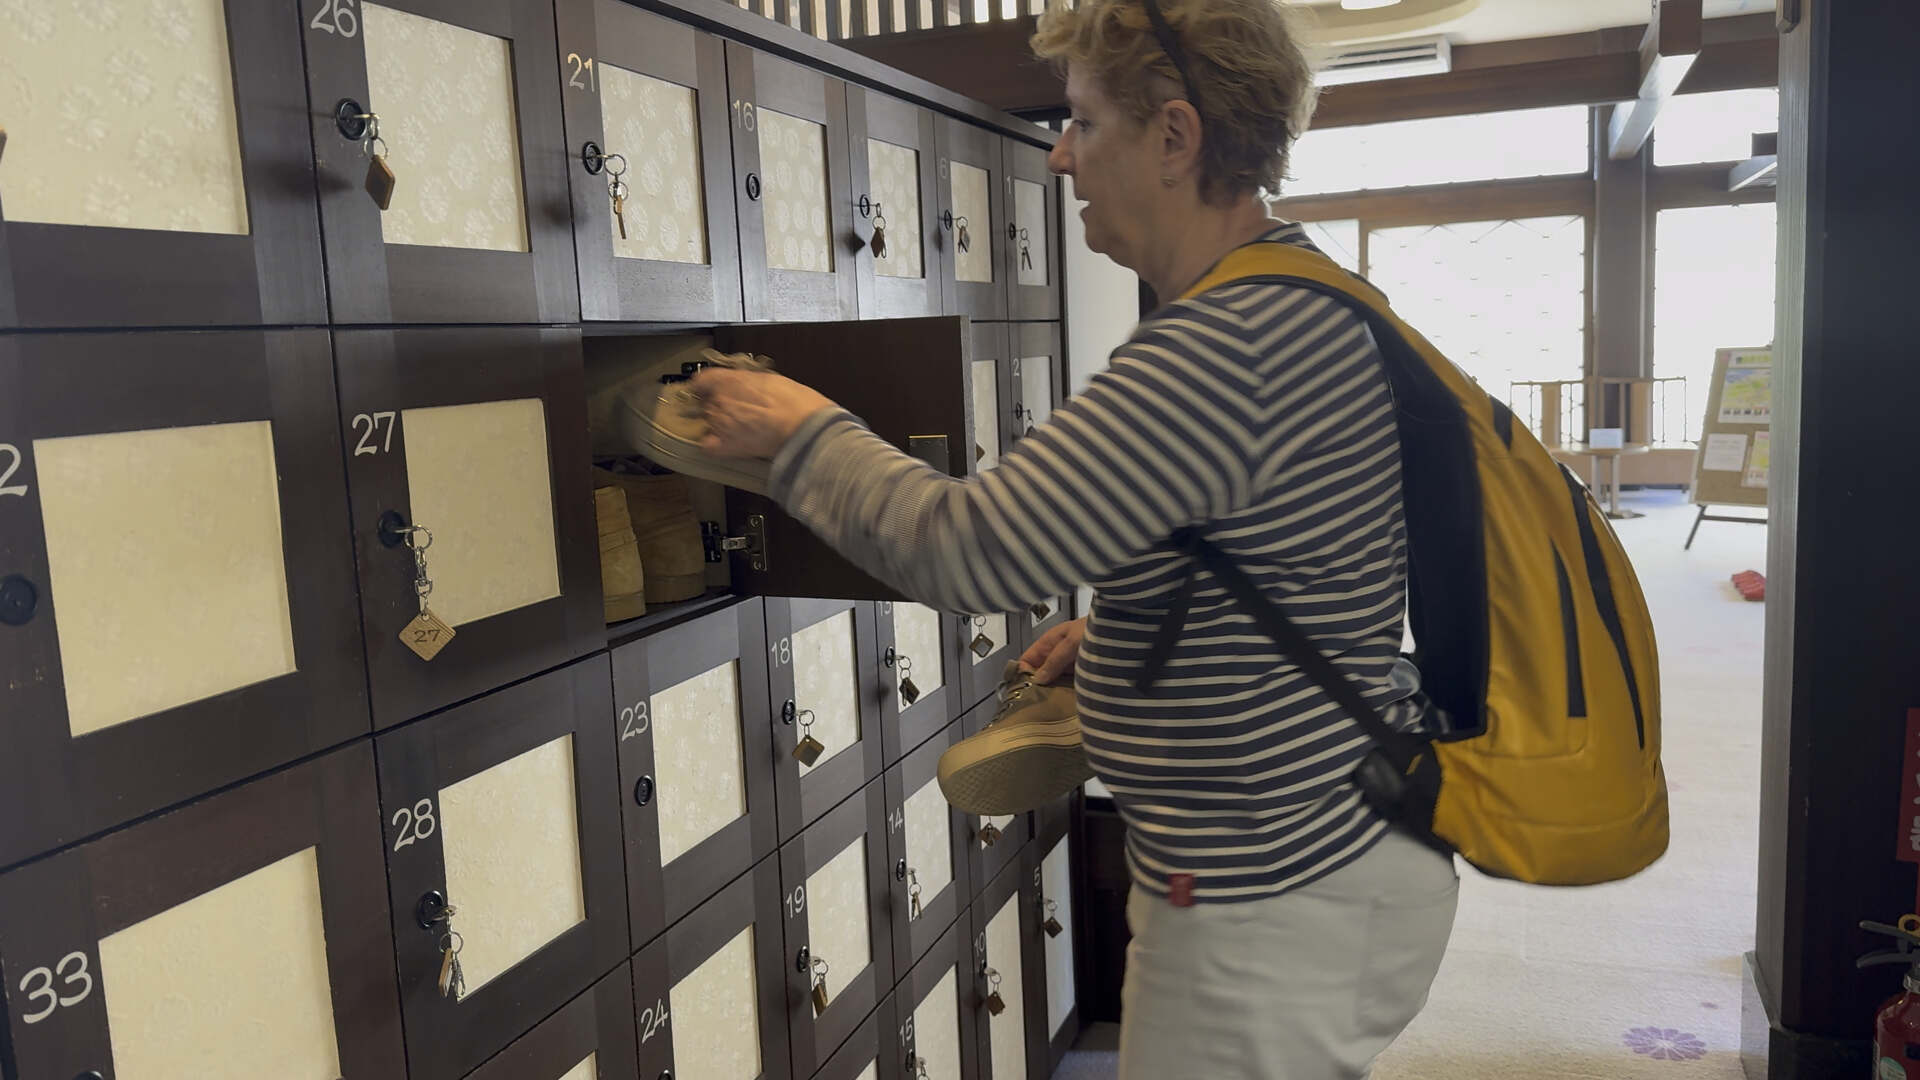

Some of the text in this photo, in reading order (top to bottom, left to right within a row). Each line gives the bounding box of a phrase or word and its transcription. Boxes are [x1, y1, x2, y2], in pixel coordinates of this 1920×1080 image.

[310, 0, 356, 37] 26
[568, 53, 595, 92] 21
[733, 99, 755, 132] 16
[1006, 175, 1012, 194] 1
[1013, 357, 1021, 377] 2
[352, 411, 395, 456] 27
[0, 444, 28, 496] 2
[414, 629, 441, 643] 27
[771, 638, 790, 668] 18
[620, 700, 649, 741] 23
[392, 799, 435, 851] 28
[888, 807, 903, 834] 14
[1034, 867, 1041, 886] 5
[786, 885, 805, 918] 19
[974, 931, 986, 957] 10
[19, 951, 93, 1024] 33
[641, 998, 669, 1044] 24
[900, 1016, 913, 1047] 15
